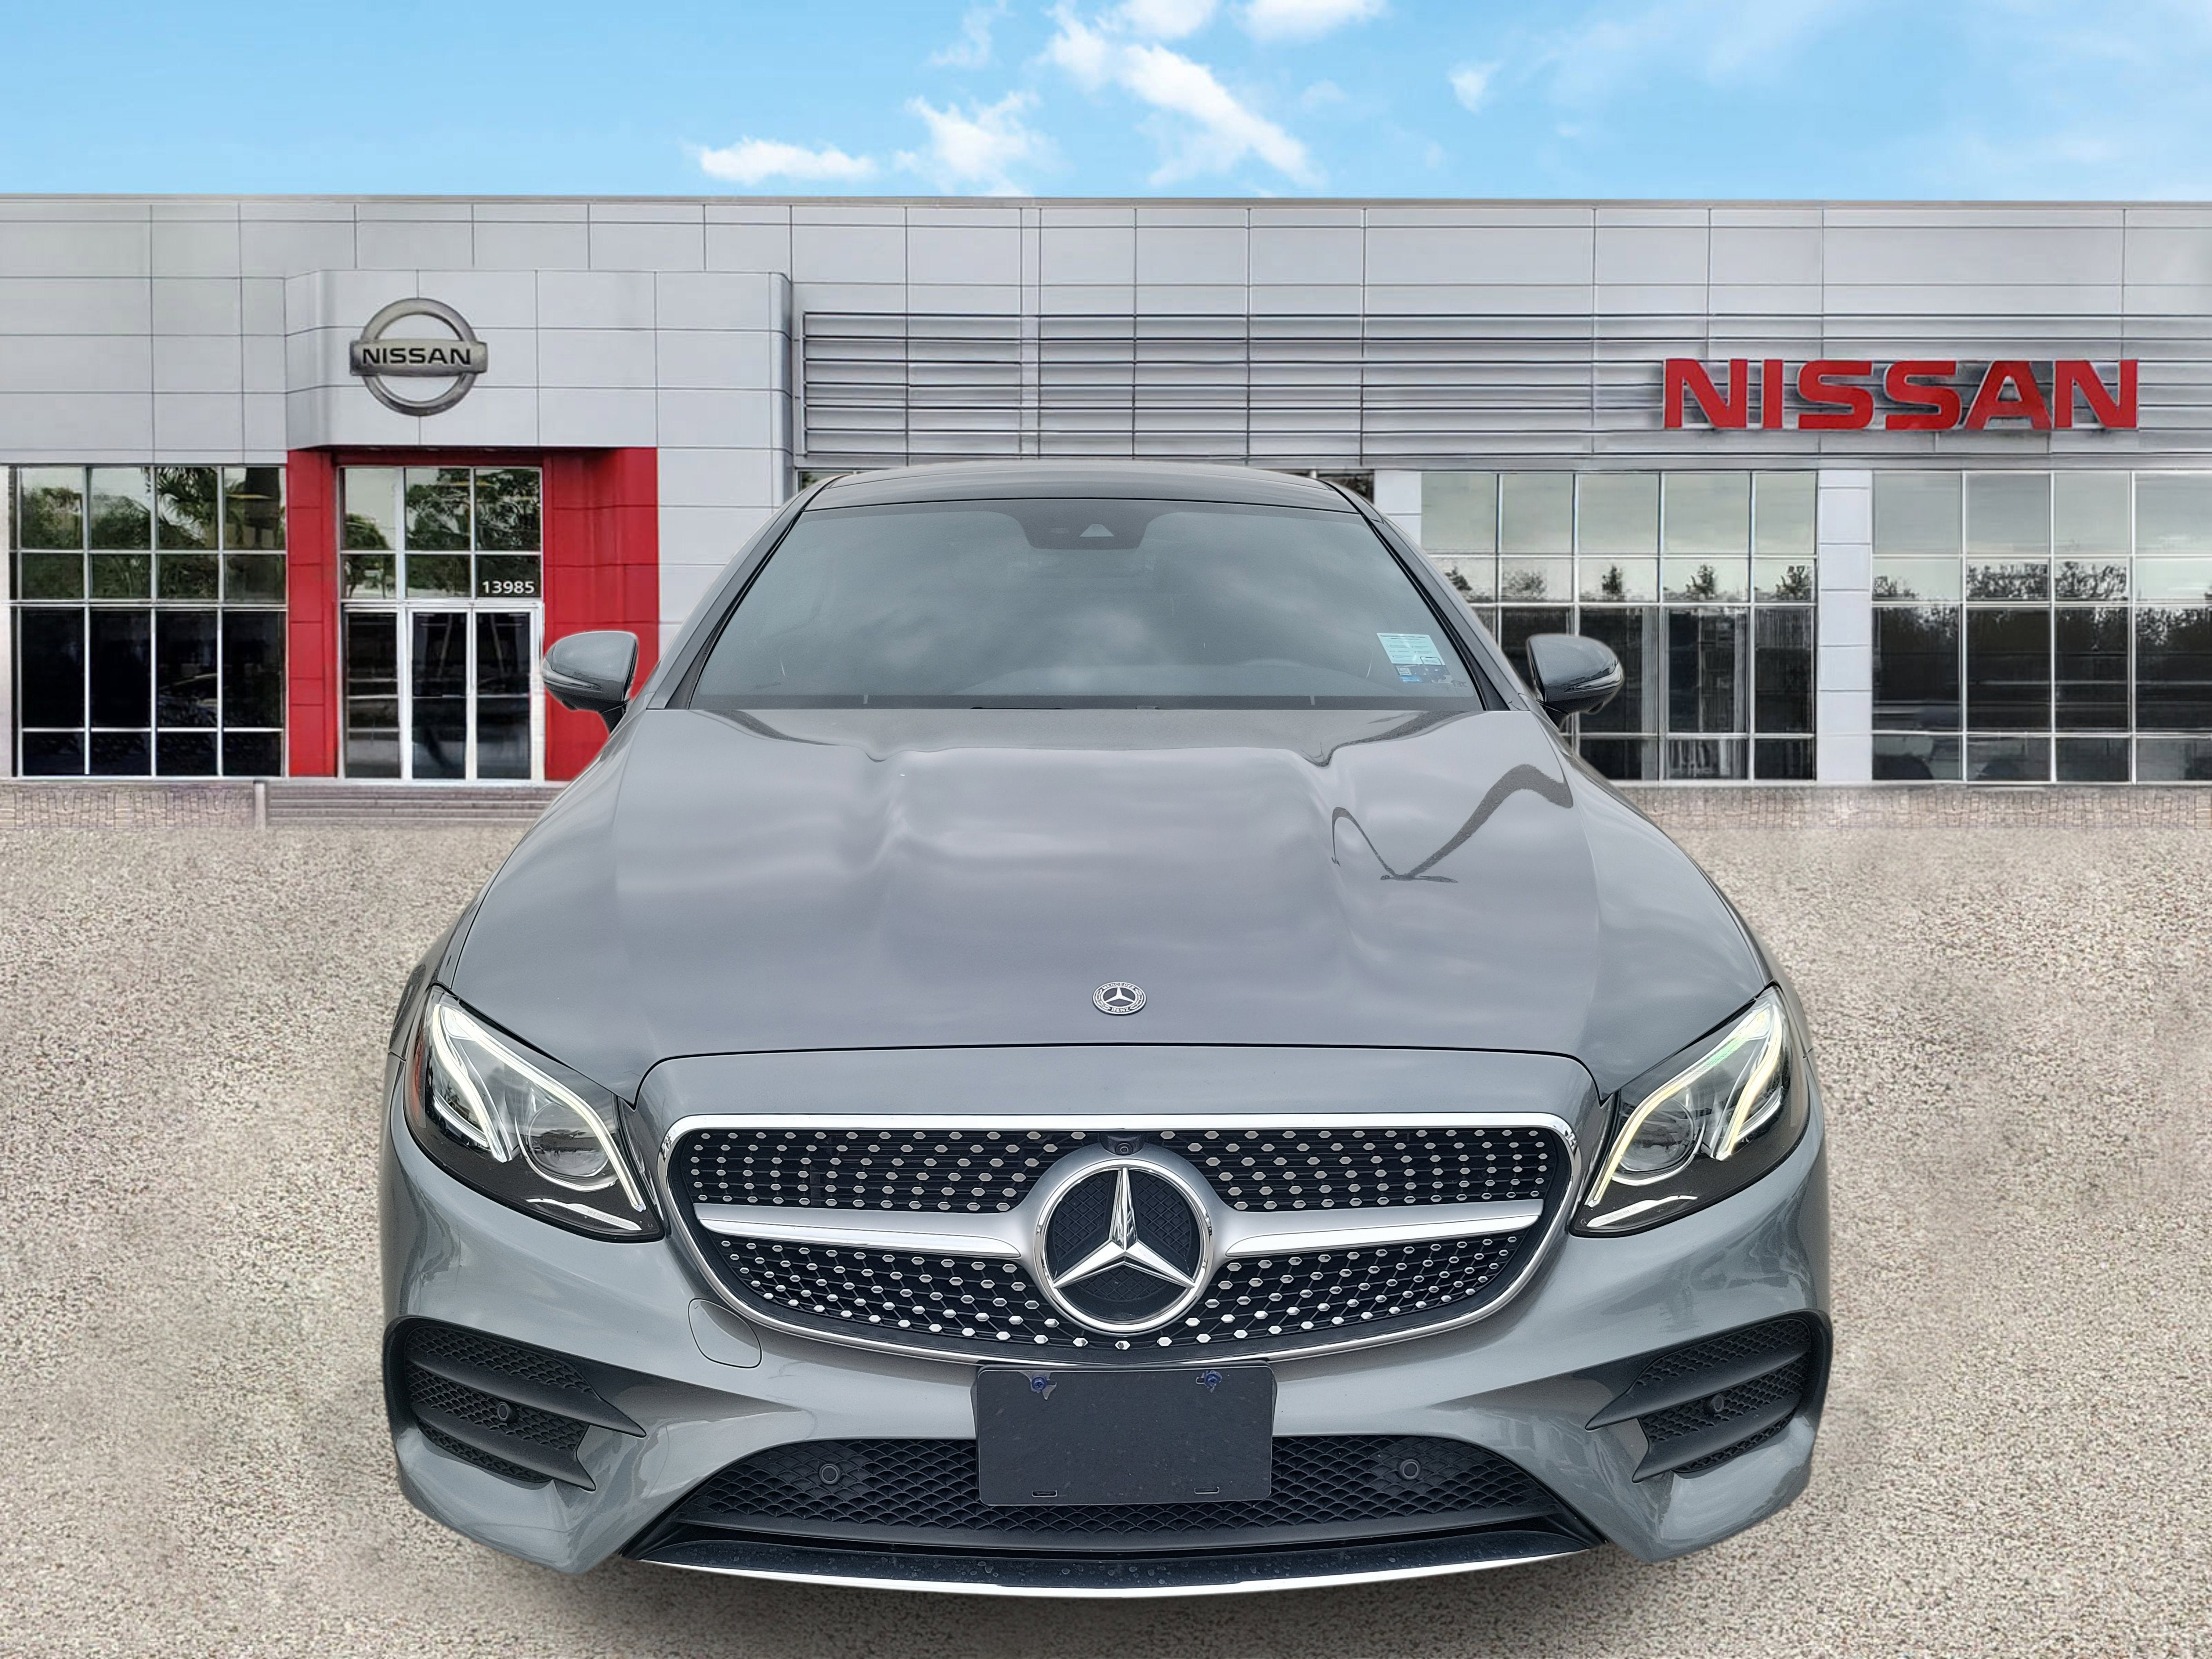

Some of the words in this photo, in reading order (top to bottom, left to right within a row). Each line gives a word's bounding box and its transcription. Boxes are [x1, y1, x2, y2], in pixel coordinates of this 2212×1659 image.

[363, 348, 470, 365] NISSAN
[1664, 358, 2139, 429] NISSAN
[482, 580, 535, 594] 13985
